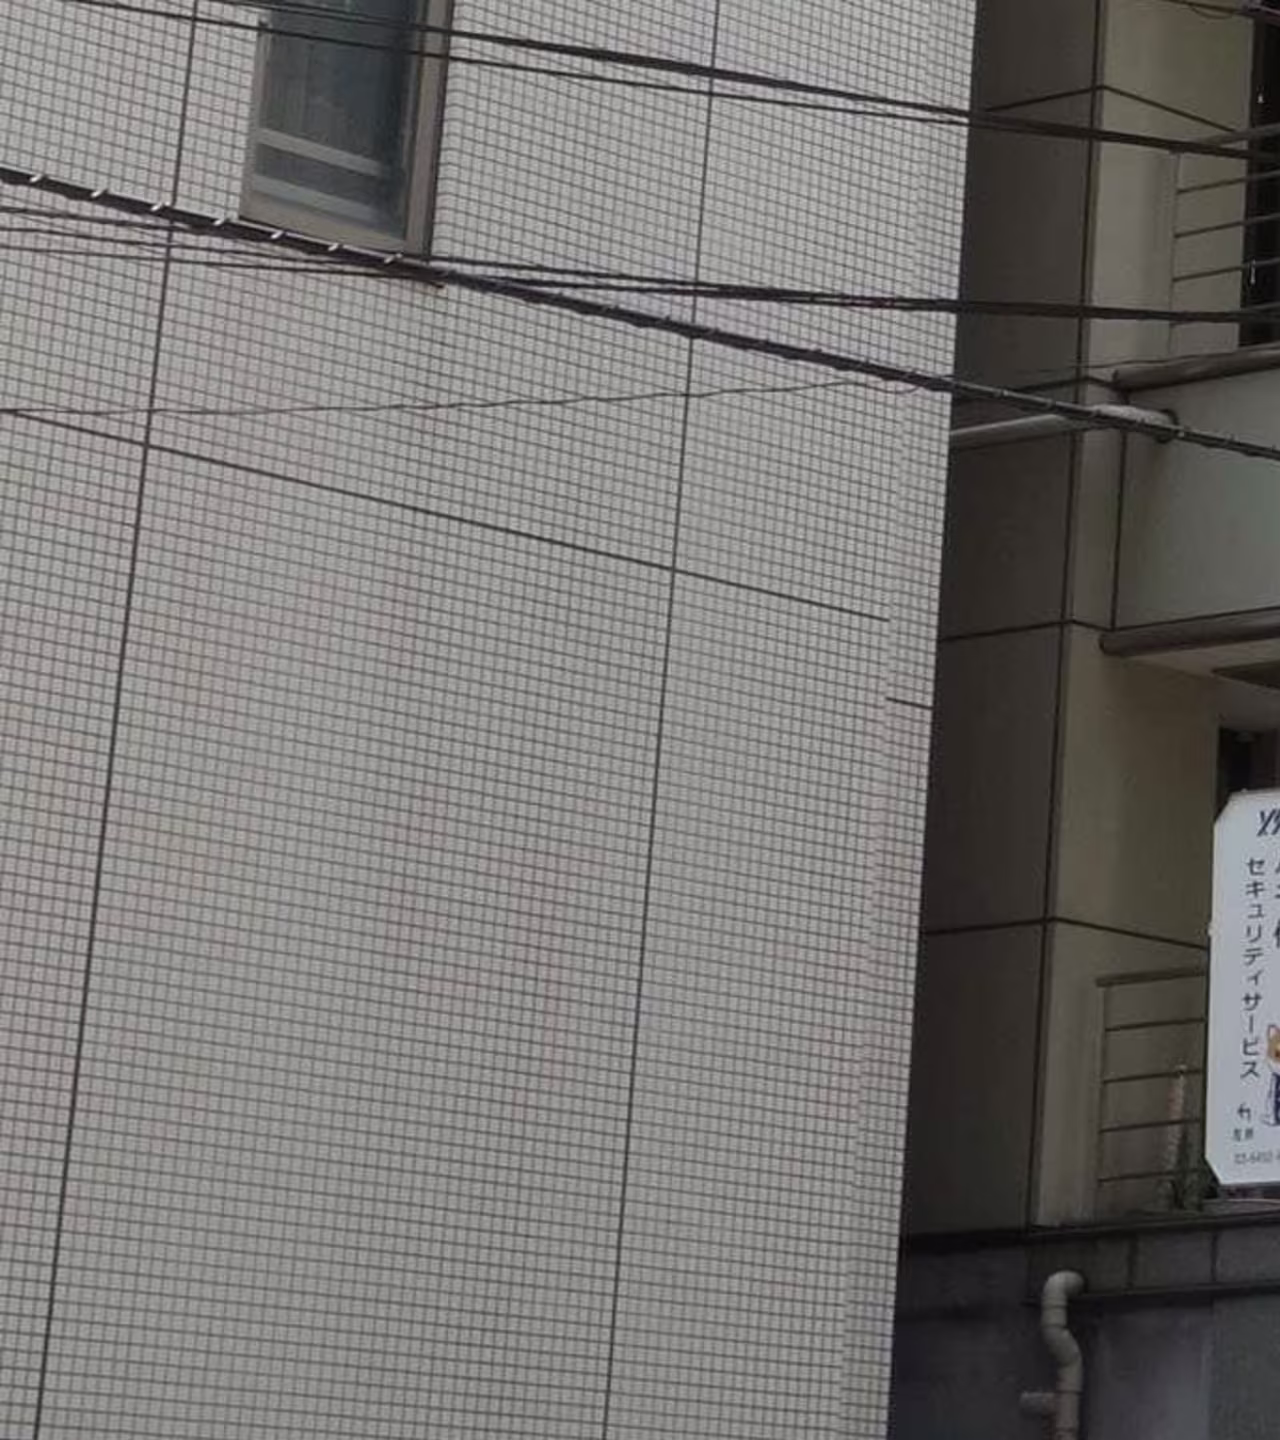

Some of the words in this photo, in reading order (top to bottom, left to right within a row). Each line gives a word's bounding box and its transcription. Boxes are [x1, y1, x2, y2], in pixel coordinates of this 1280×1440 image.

[1239, 857, 1268, 1080] セキュリティサービス
